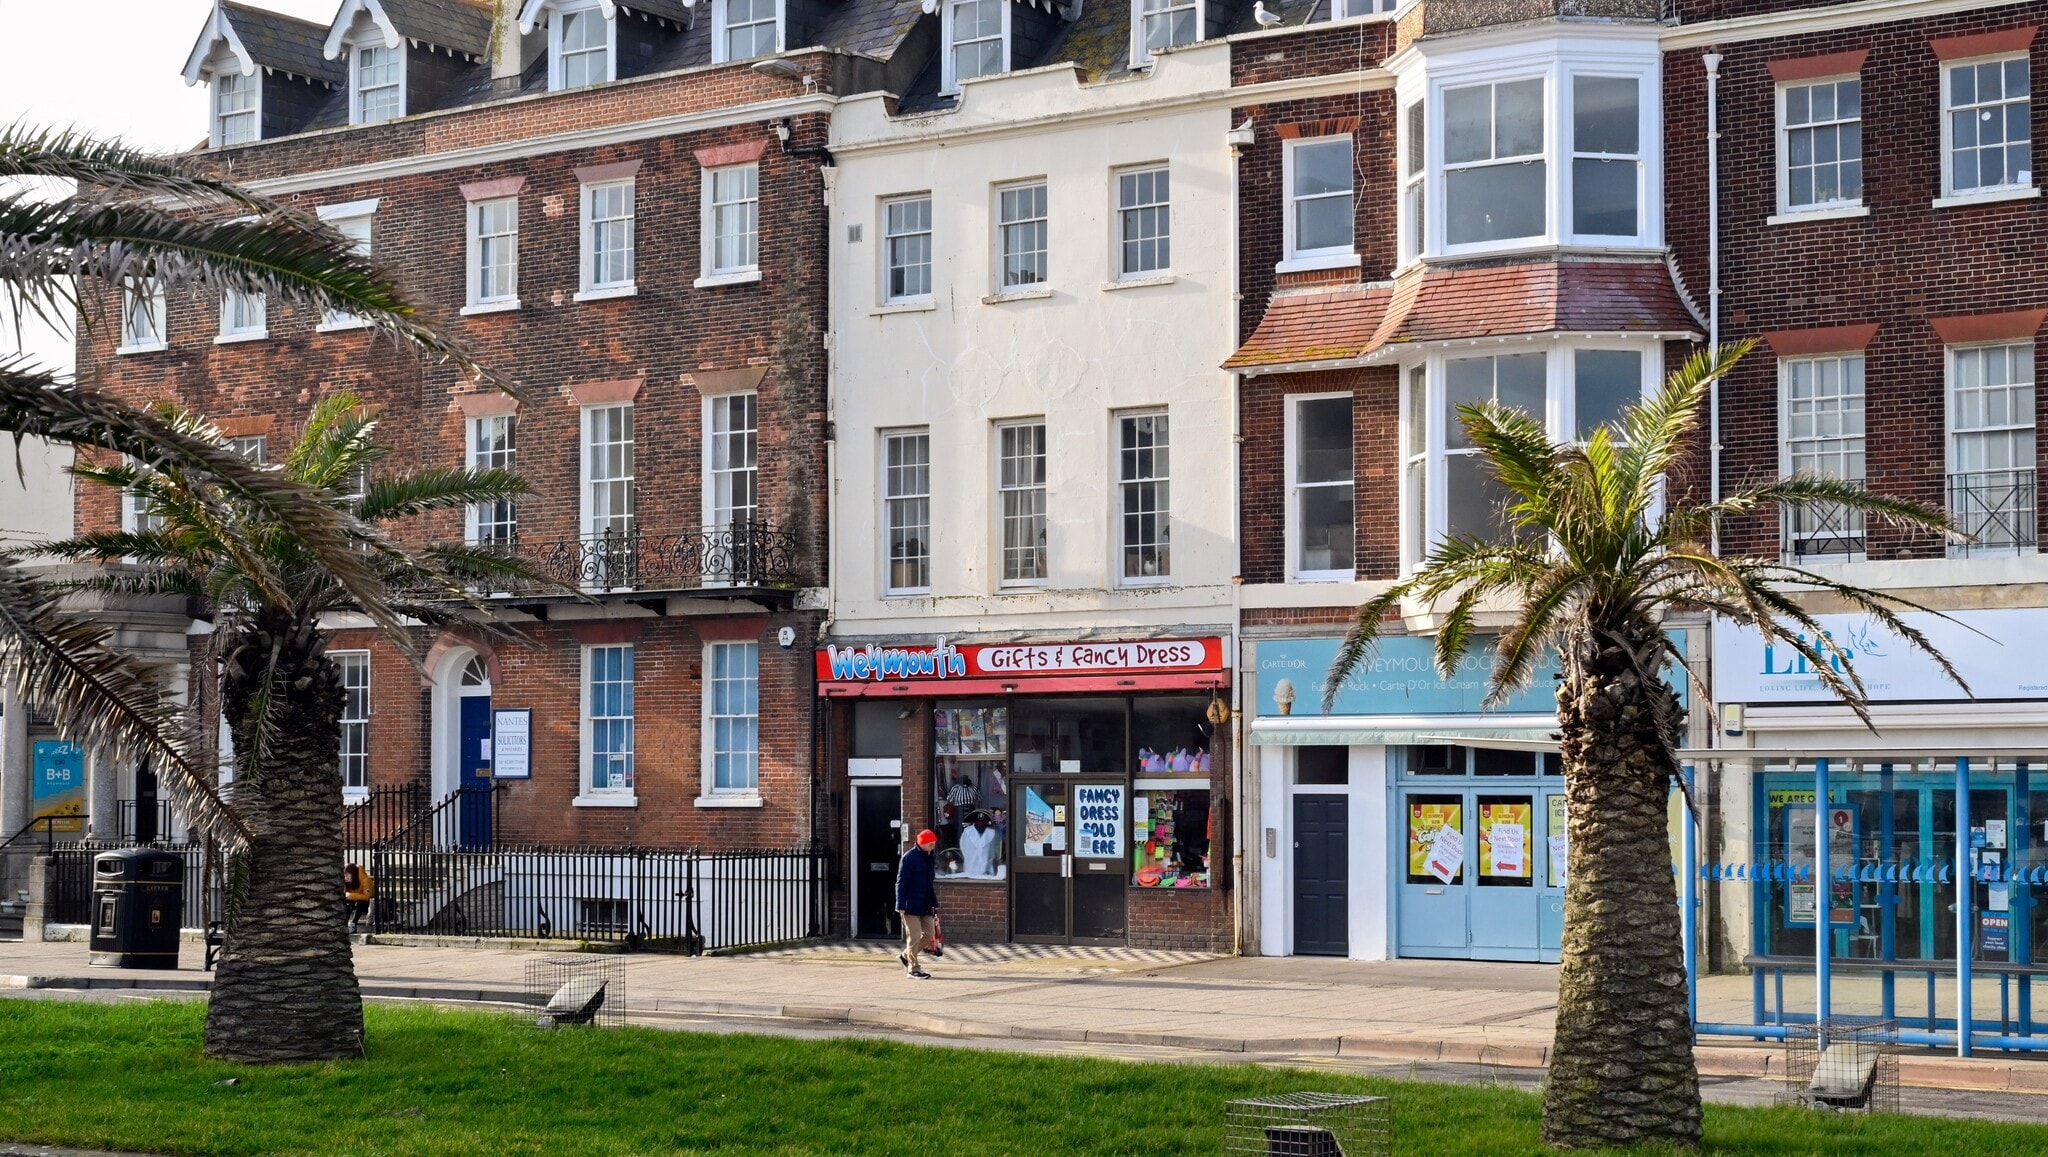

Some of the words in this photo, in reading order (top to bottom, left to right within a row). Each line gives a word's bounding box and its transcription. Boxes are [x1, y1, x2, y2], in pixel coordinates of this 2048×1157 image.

[828, 635, 966, 681] Weymouth
[991, 647, 1048, 669] Gifts
[1055, 646, 1063, 667] &
[1136, 644, 1190, 664] Dress
[1760, 630, 1854, 675] Life
[1379, 679, 1406, 691] Carte
[1433, 679, 1447, 690] Ice
[1449, 678, 1479, 689] Cream
[1867, 683, 1890, 691] HOPE
[497, 716, 528, 726] NANTES
[46, 768, 71, 780] B+B
[1079, 788, 1120, 804] FANCY
[1770, 794, 1784, 803] WE
[1787, 794, 1805, 803] ARE
[1808, 794, 1835, 804] ON
[1080, 806, 1119, 821] DRESS
[1083, 822, 1116, 838] SOLD
[1982, 918, 2008, 927] OPEN
